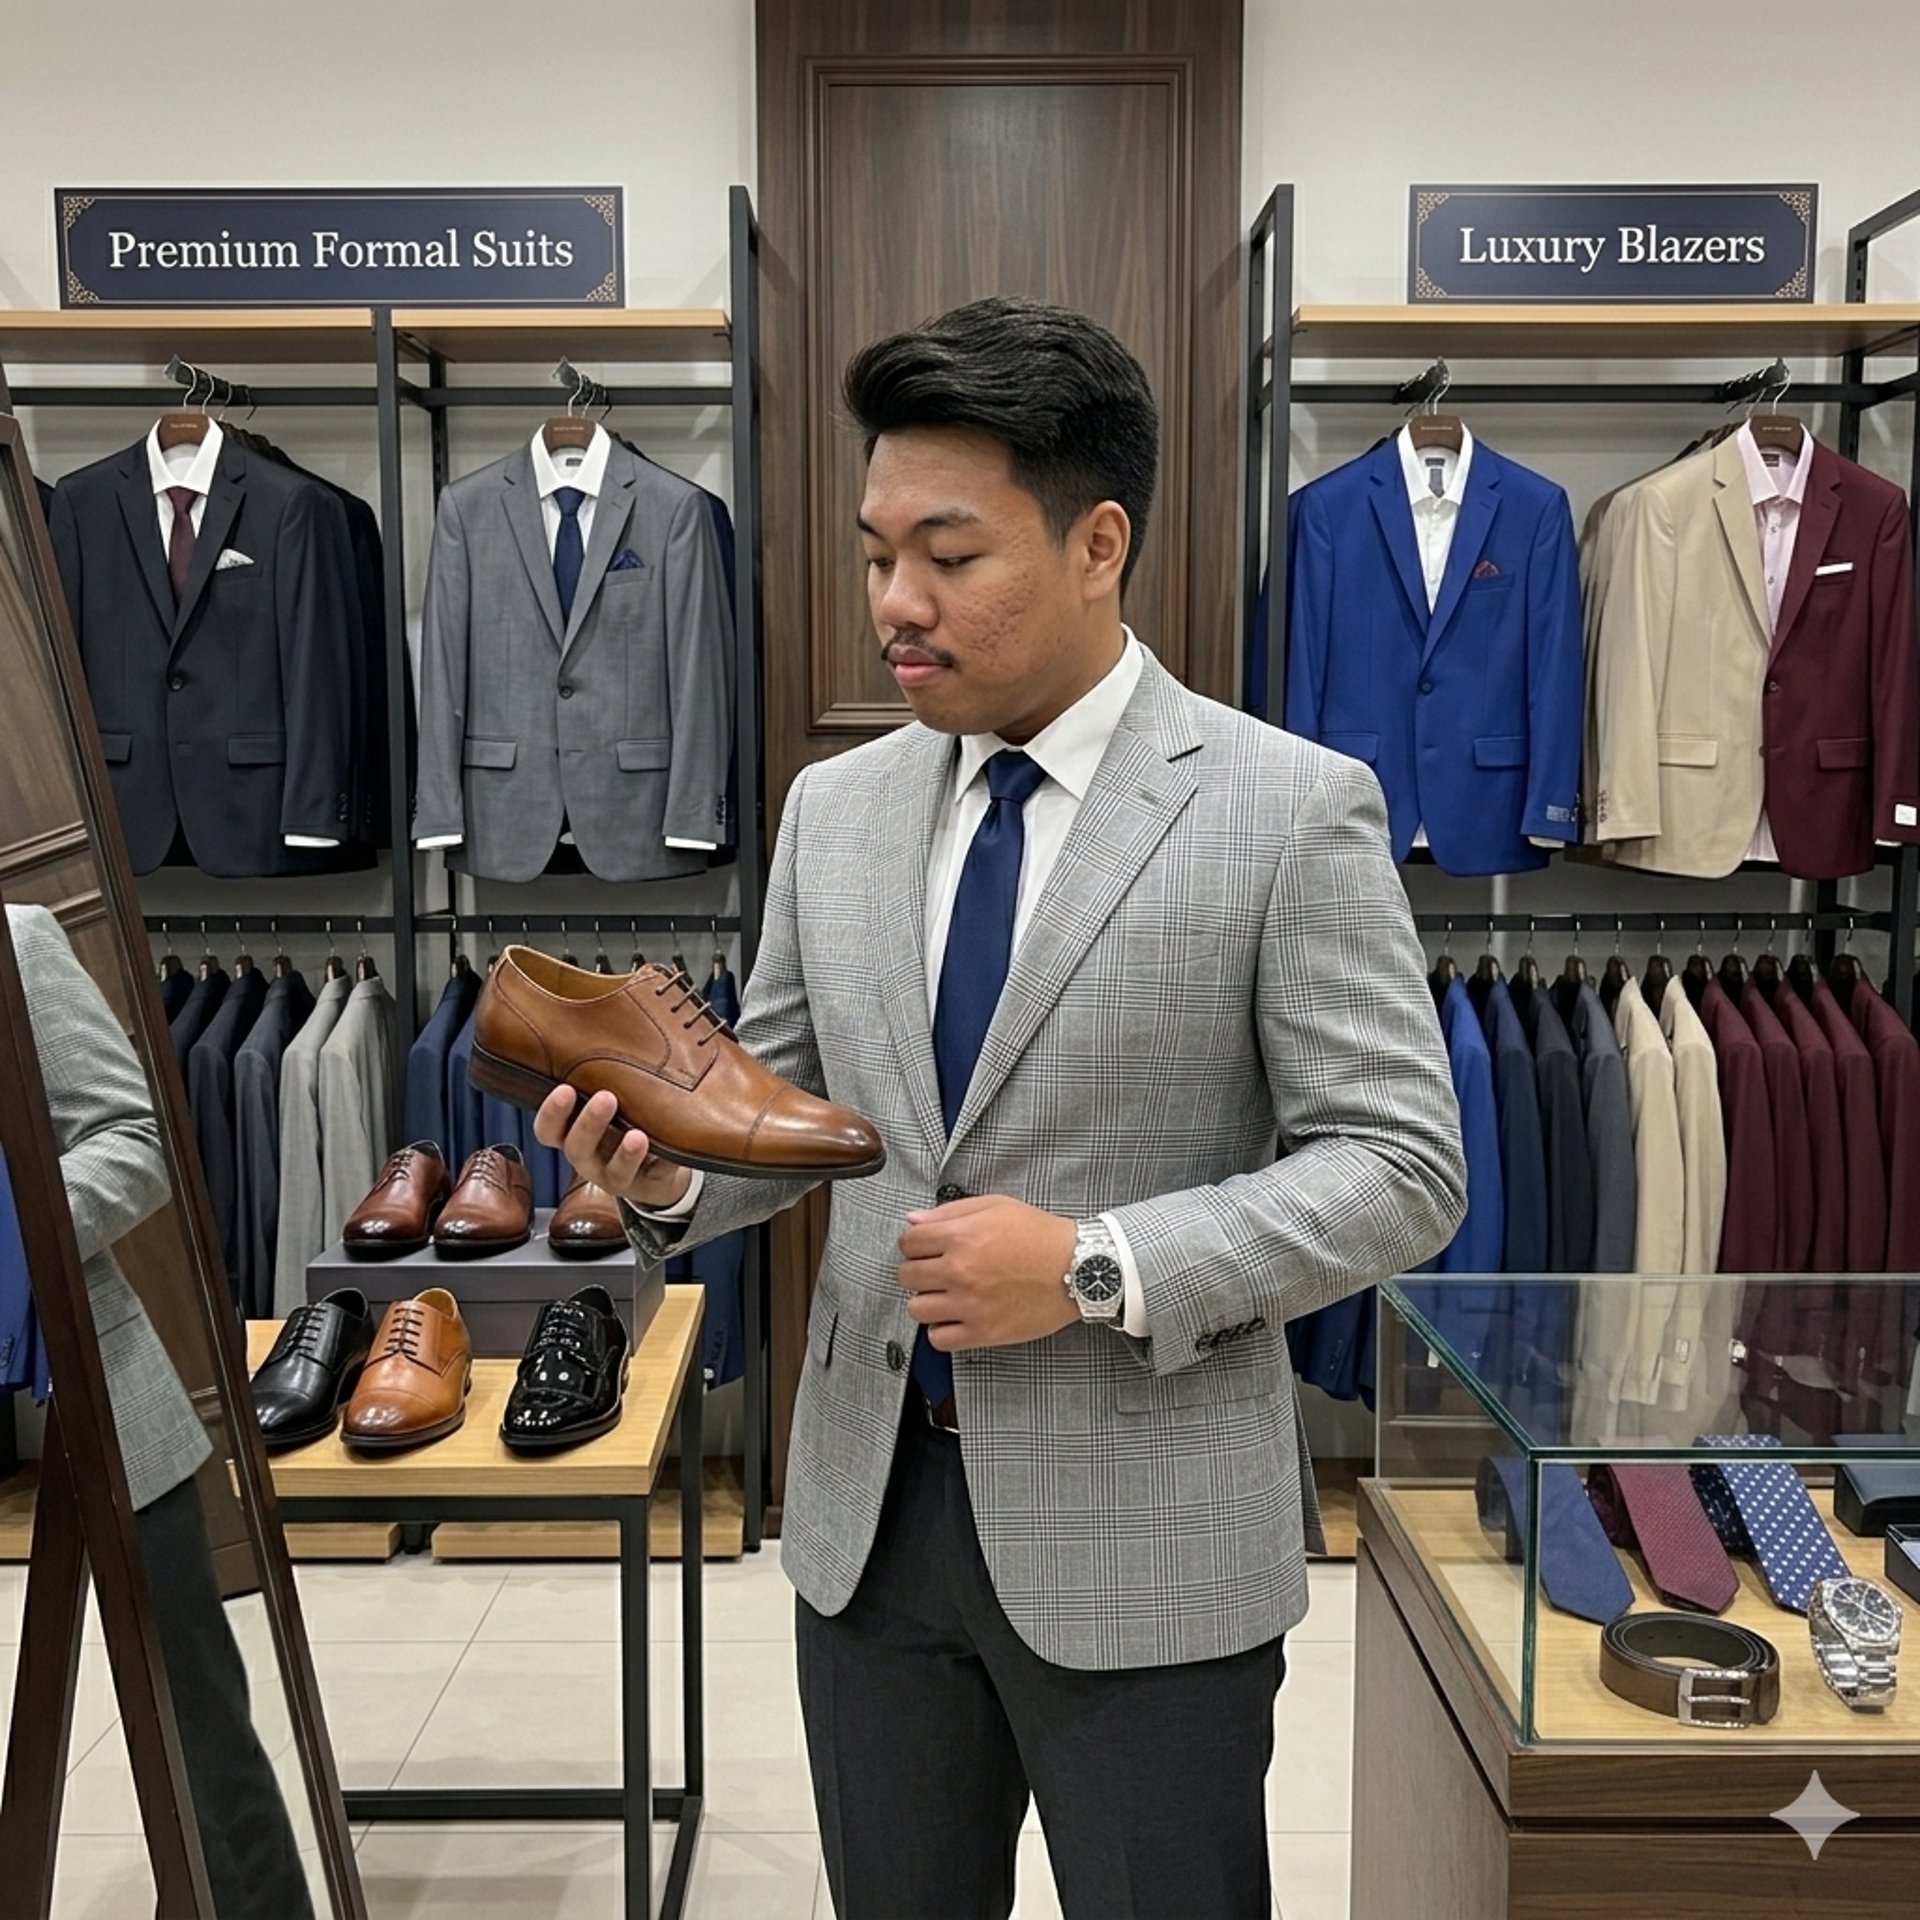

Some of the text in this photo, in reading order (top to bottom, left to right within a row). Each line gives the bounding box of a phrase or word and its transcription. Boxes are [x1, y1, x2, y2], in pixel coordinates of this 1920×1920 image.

[109, 228, 575, 269] Premium Formal Suits
[1459, 224, 1766, 273] Luxury Blazers
